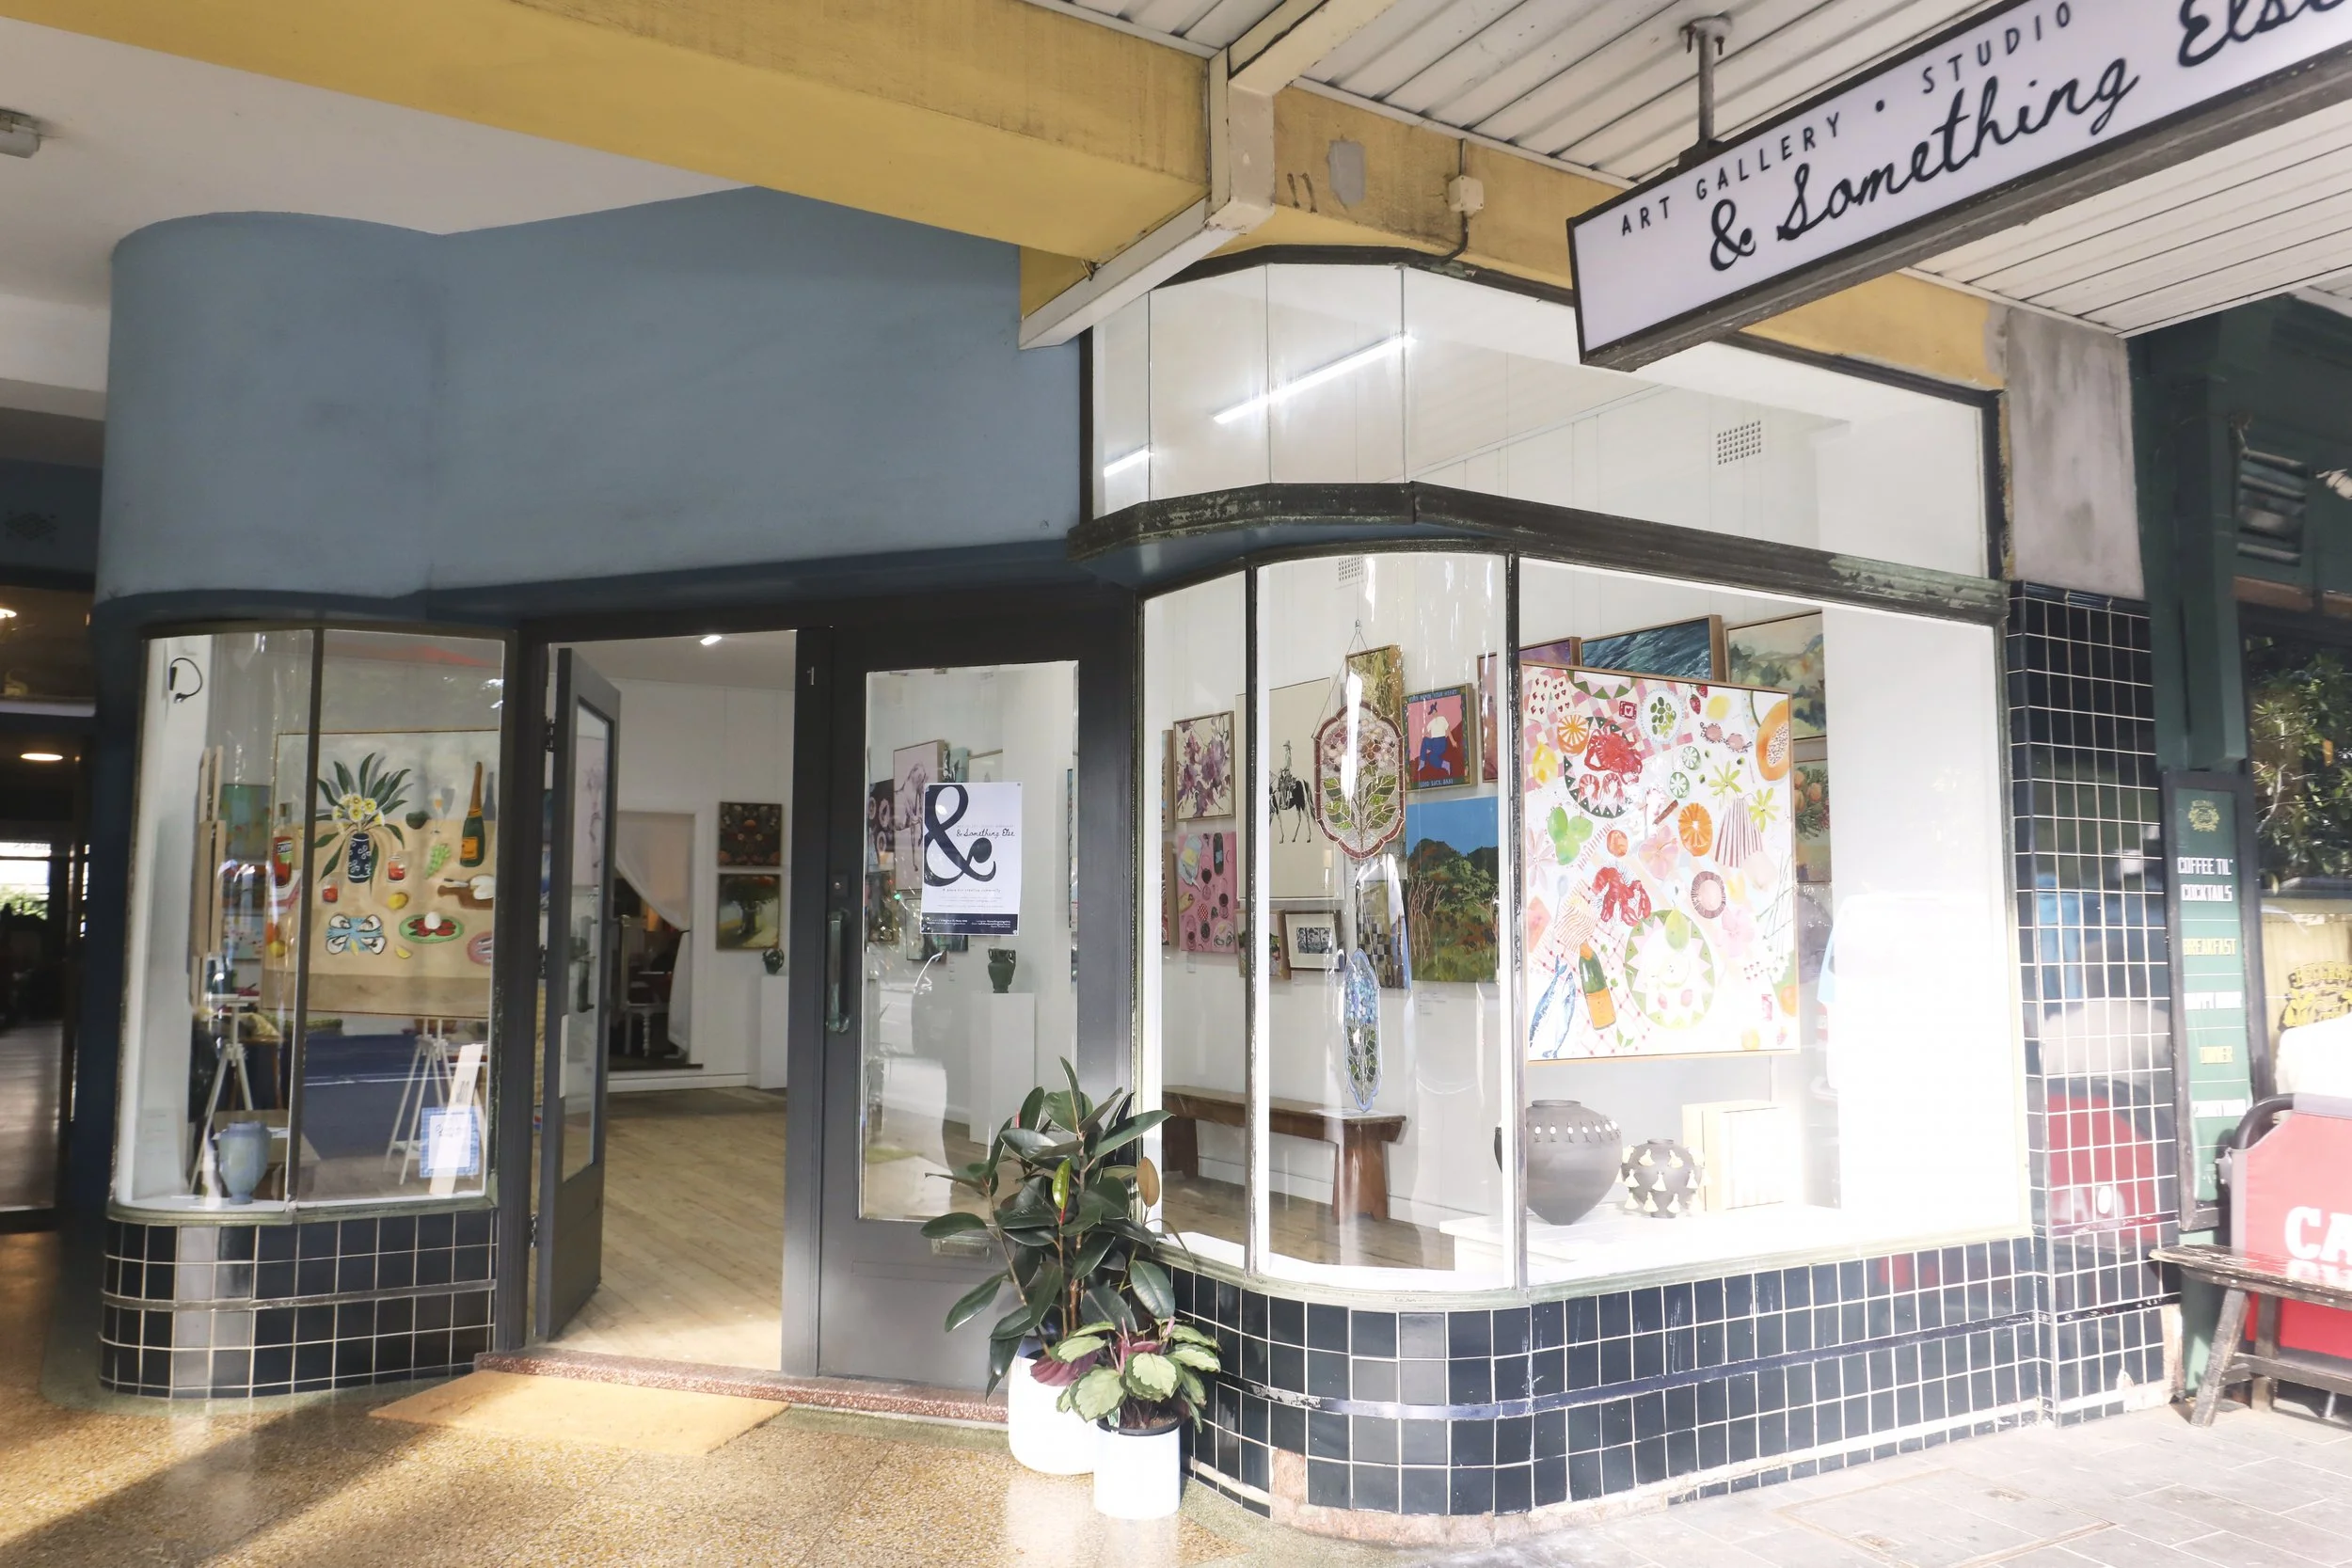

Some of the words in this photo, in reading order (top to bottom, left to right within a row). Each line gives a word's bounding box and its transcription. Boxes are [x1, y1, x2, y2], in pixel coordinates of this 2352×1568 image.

[1622, 197, 1670, 235] ART
[1696, 112, 1840, 200] GALLERY
[1922, 2, 2072, 94] STUDIO
[1709, 198, 1756, 271] &
[1776, 57, 2140, 242] Something
[963, 828, 1000, 839] Something
[1002, 828, 1015, 837] Else
[2177, 856, 2215, 875] COFFEE
[2180, 884, 2233, 902] COCKTAILS
[2182, 938, 2235, 955] BREAKFAST
